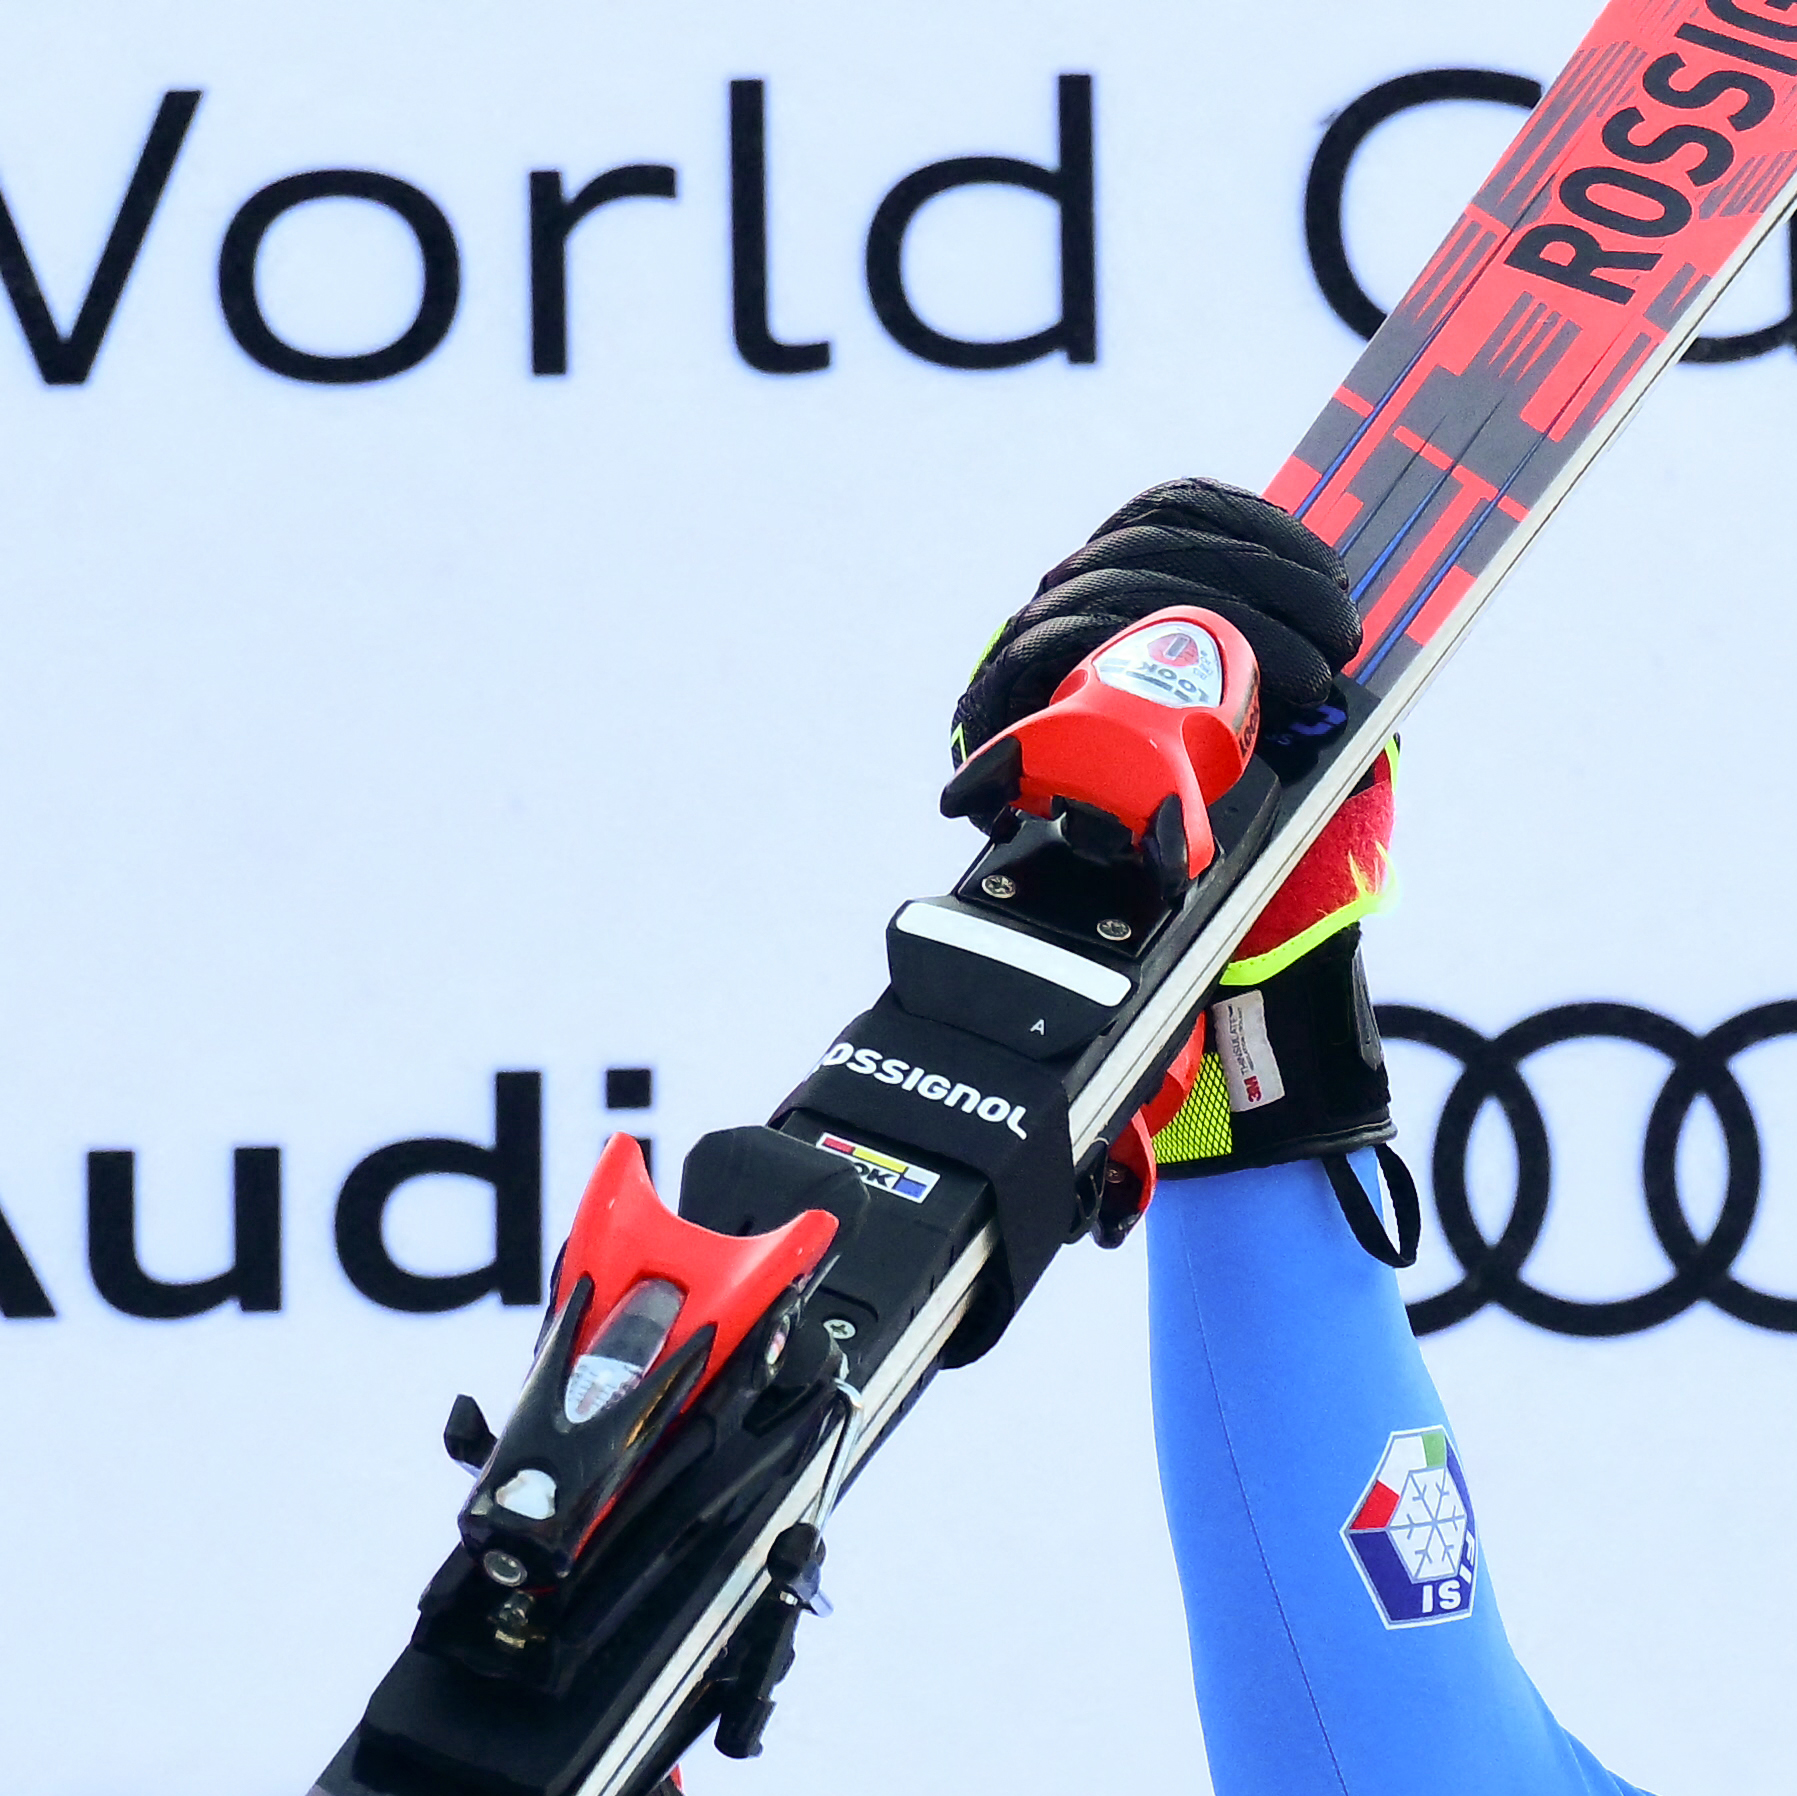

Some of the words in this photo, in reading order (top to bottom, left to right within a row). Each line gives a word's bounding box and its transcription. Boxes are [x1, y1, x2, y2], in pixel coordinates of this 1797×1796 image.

[1030, 1018, 1046, 1036] A
[813, 1042, 1028, 1141] OSSIGNOL
[1243, 1075, 1262, 1103] 3M
